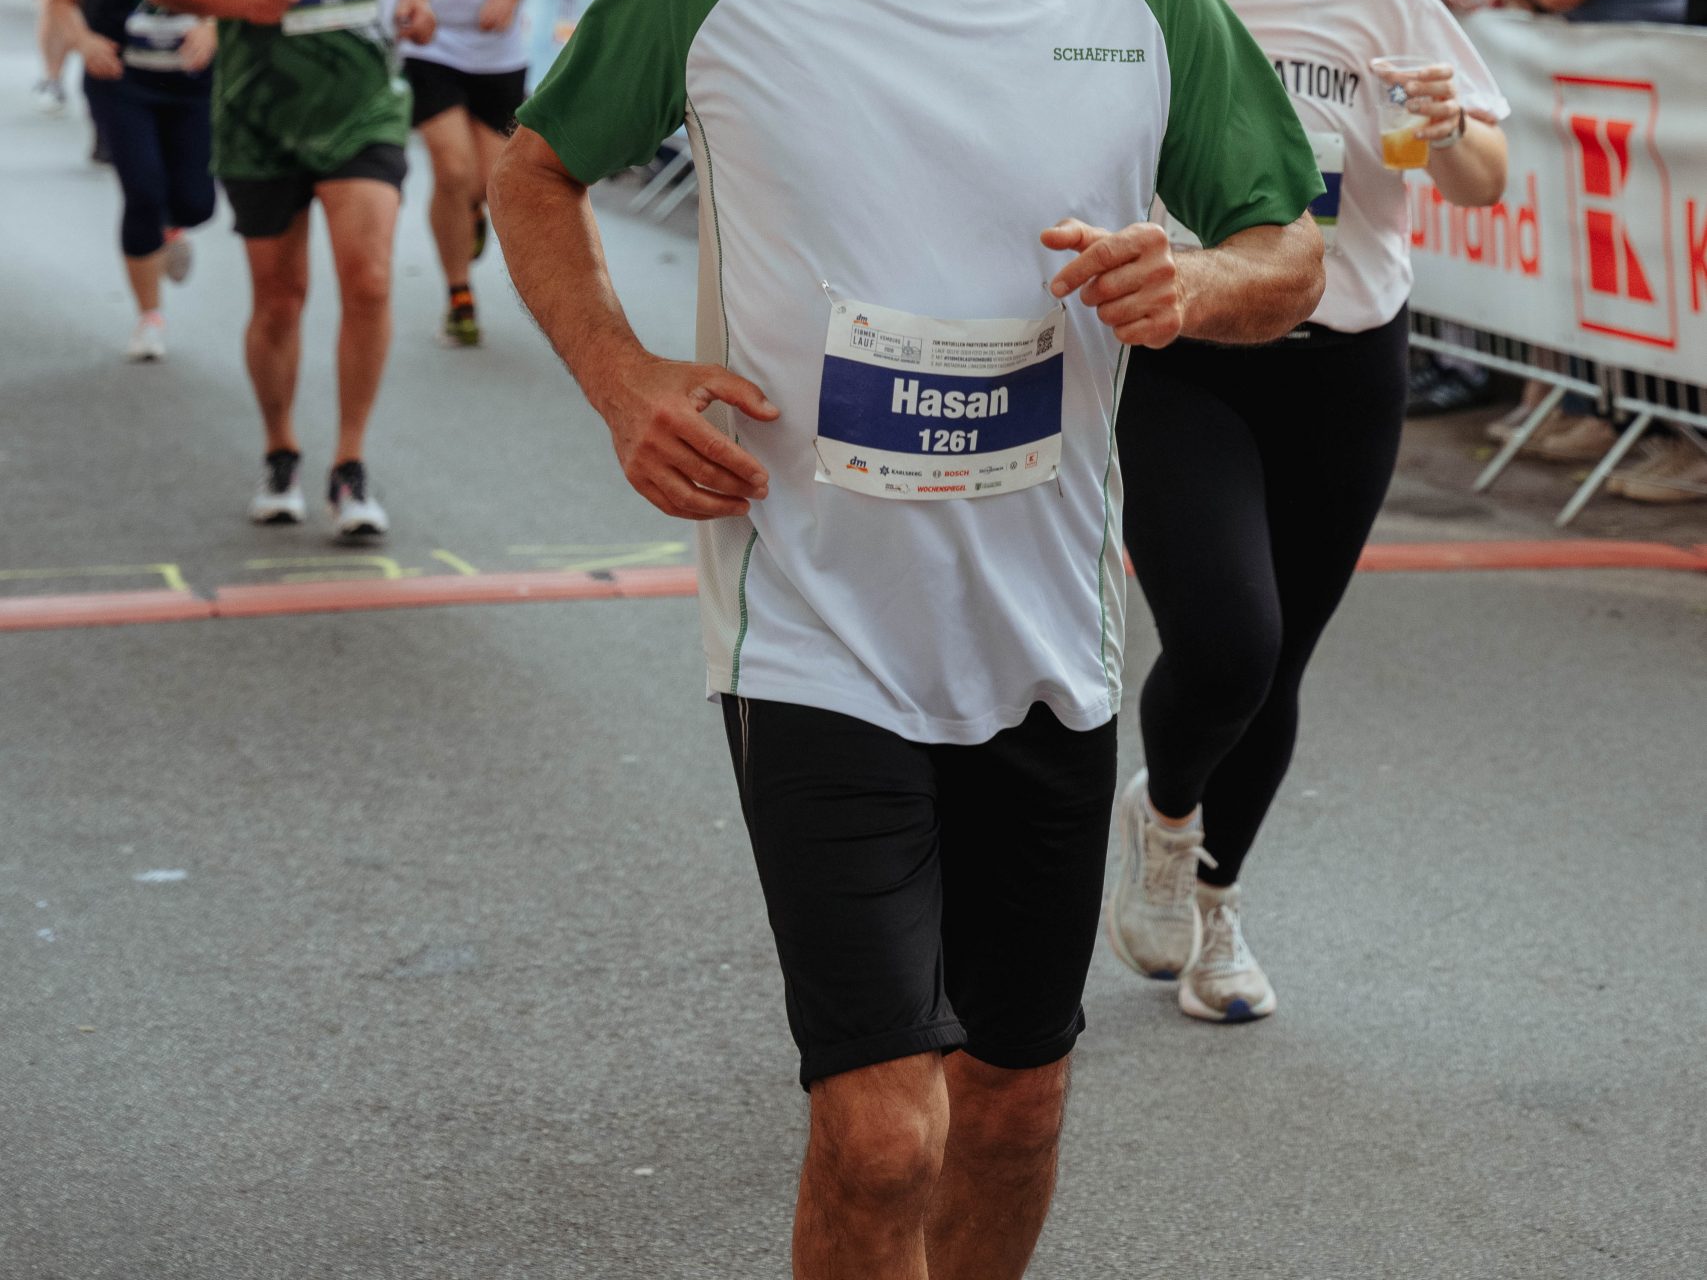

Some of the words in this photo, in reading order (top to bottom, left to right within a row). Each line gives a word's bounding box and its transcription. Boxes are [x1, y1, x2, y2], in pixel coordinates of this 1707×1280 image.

[1053, 47, 1146, 63] SCHAEFFLER
[1274, 60, 1360, 107] ATION?
[856, 313, 868, 322] dm
[854, 327, 876, 338] FIRMEN
[853, 336, 875, 348] LAUF
[891, 377, 1009, 419] Hasan
[919, 428, 978, 452] 1261
[850, 456, 867, 468] dm
[891, 468, 922, 477] KARLSBERG
[917, 485, 966, 493] WOCHENSPIEGEL
